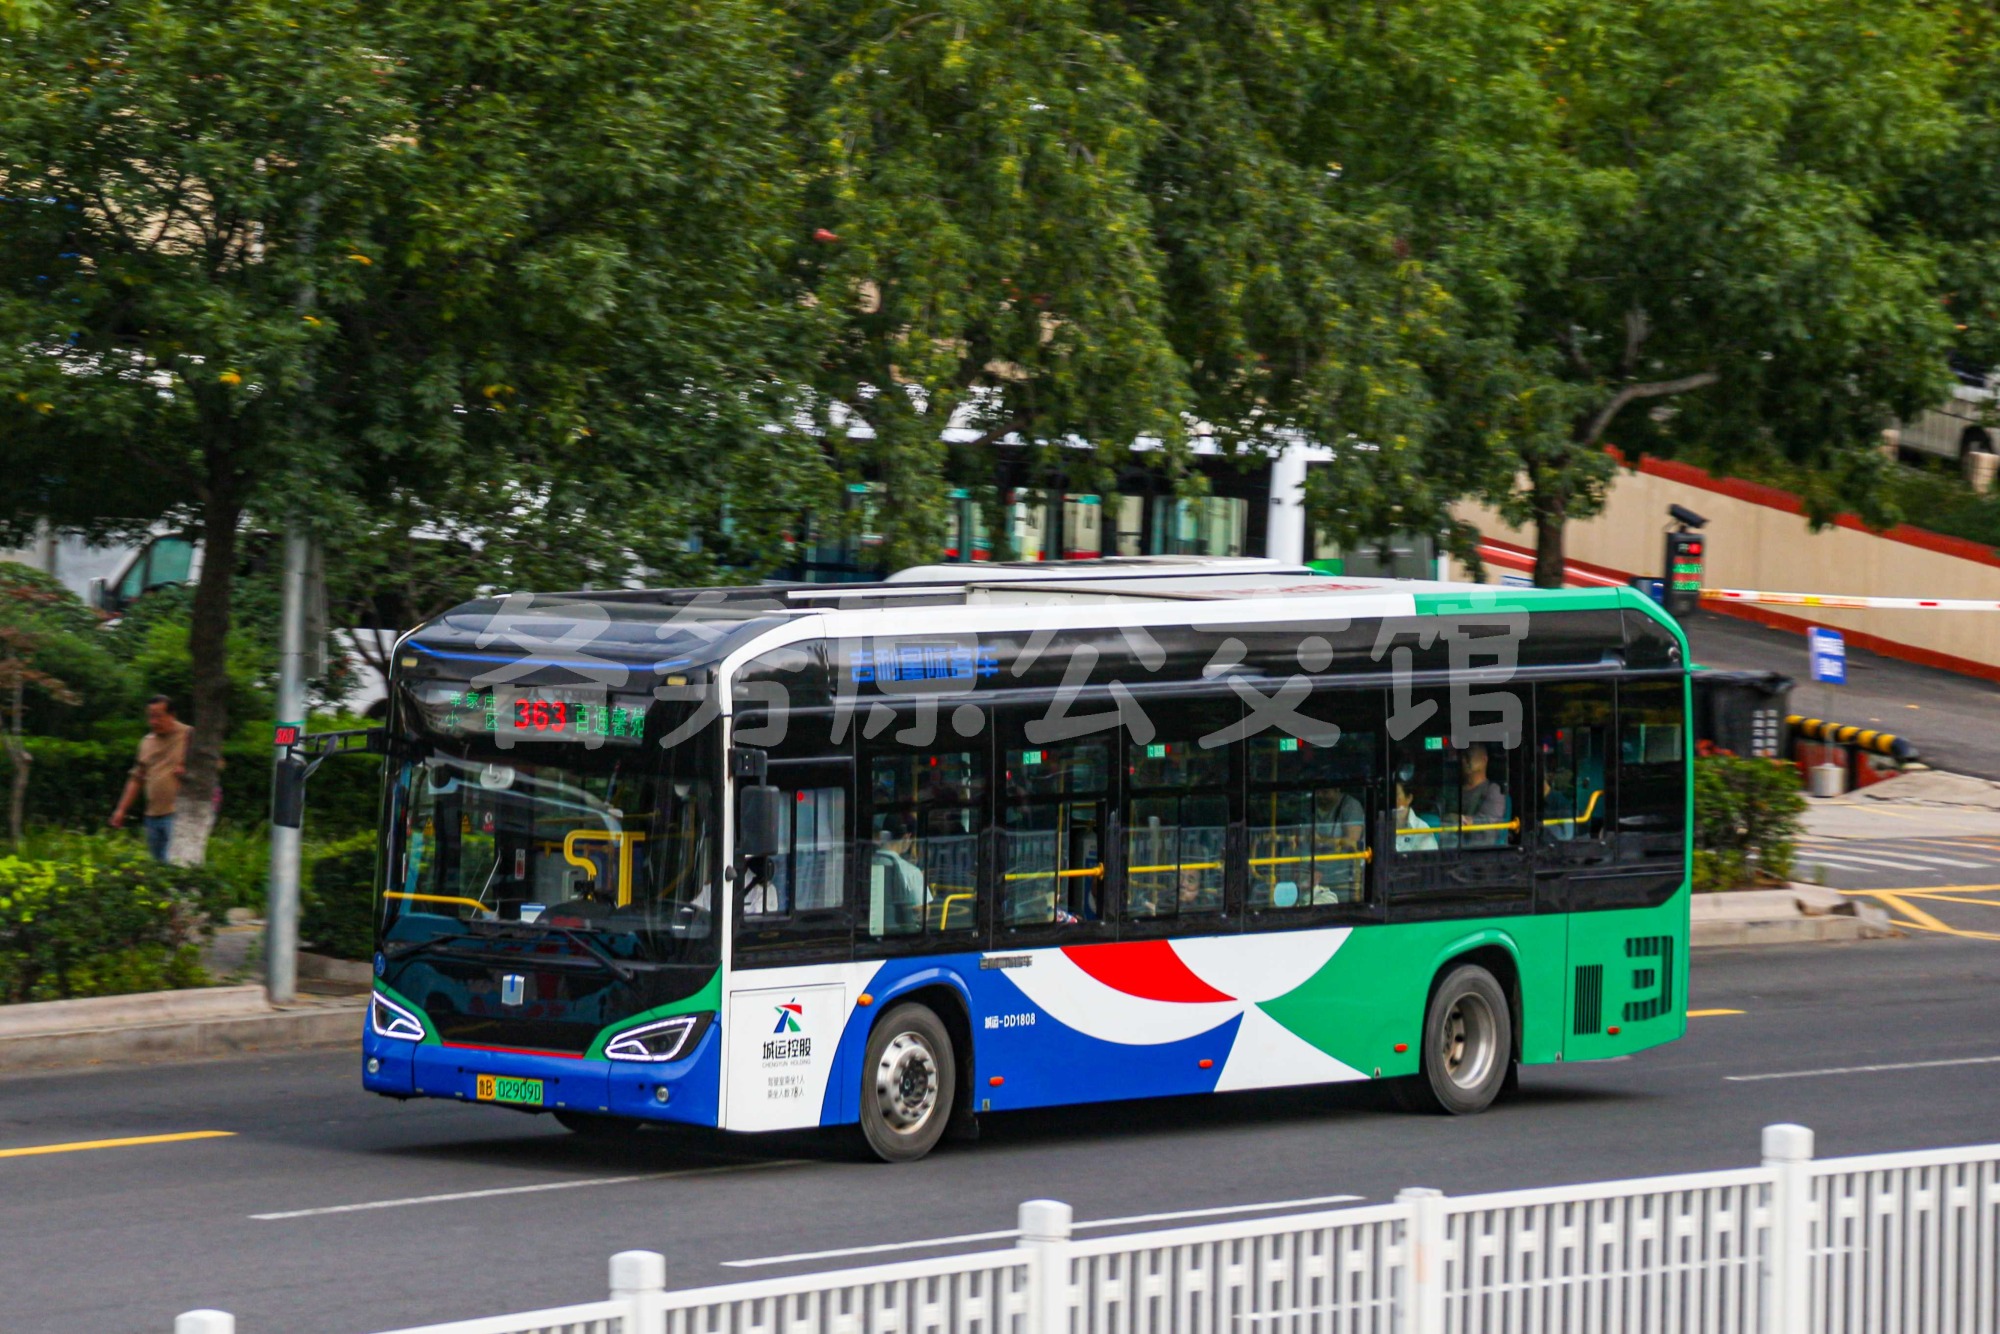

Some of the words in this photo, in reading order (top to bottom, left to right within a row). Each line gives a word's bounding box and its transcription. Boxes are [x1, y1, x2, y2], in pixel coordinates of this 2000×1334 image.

[514, 698, 567, 732] 363
[575, 703, 645, 737] 百通馨苑
[763, 1038, 811, 1059] 城运控股
